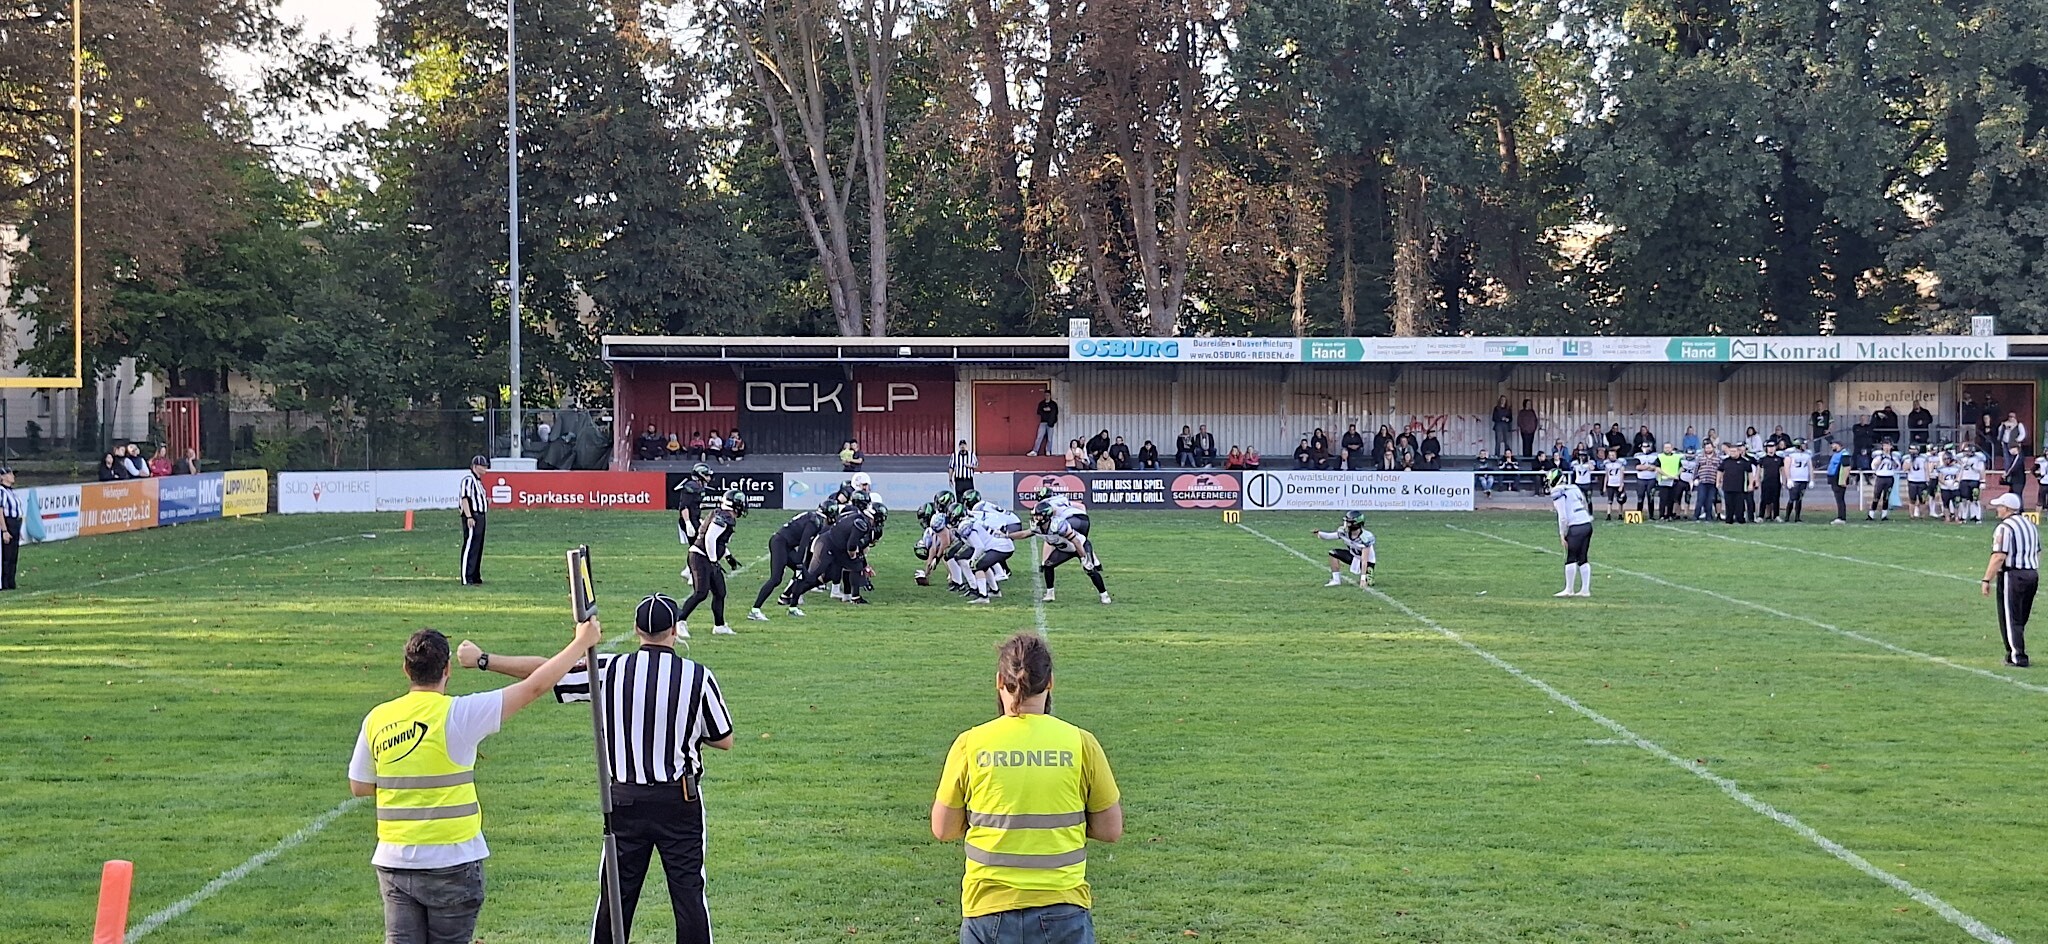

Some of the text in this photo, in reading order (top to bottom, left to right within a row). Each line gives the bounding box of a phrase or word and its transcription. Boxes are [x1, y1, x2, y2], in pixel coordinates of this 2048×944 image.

[1075, 339, 1179, 358] OSBURG
[1312, 347, 1346, 359] Hand
[1535, 347, 1554, 355] und
[1681, 346, 1716, 359] Hand
[1763, 342, 1996, 360] Konrad Mackenbrock
[856, 382, 919, 412] LP
[1858, 390, 1936, 402] Hohenfelder
[199, 479, 221, 504] HMC
[285, 480, 308, 494] SÜD
[1091, 480, 1165, 490] MEHR BISS IM SPIEL
[1287, 484, 1340, 494] Demmer
[1351, 484, 1396, 494] Duhme
[1401, 485, 1409, 494] &
[1414, 484, 1470, 498] Kollegen
[39, 494, 80, 510] UCHDOWN
[518, 491, 650, 506] Sparkasse Lippstadt
[1092, 493, 1165, 503] UND AUF DEM GRILL
[1172, 491, 1238, 500] SCHÄFERMEIER
[1226, 511, 1238, 523] 10
[1628, 513, 1640, 523] 20
[976, 750, 1073, 767] ORDNER
